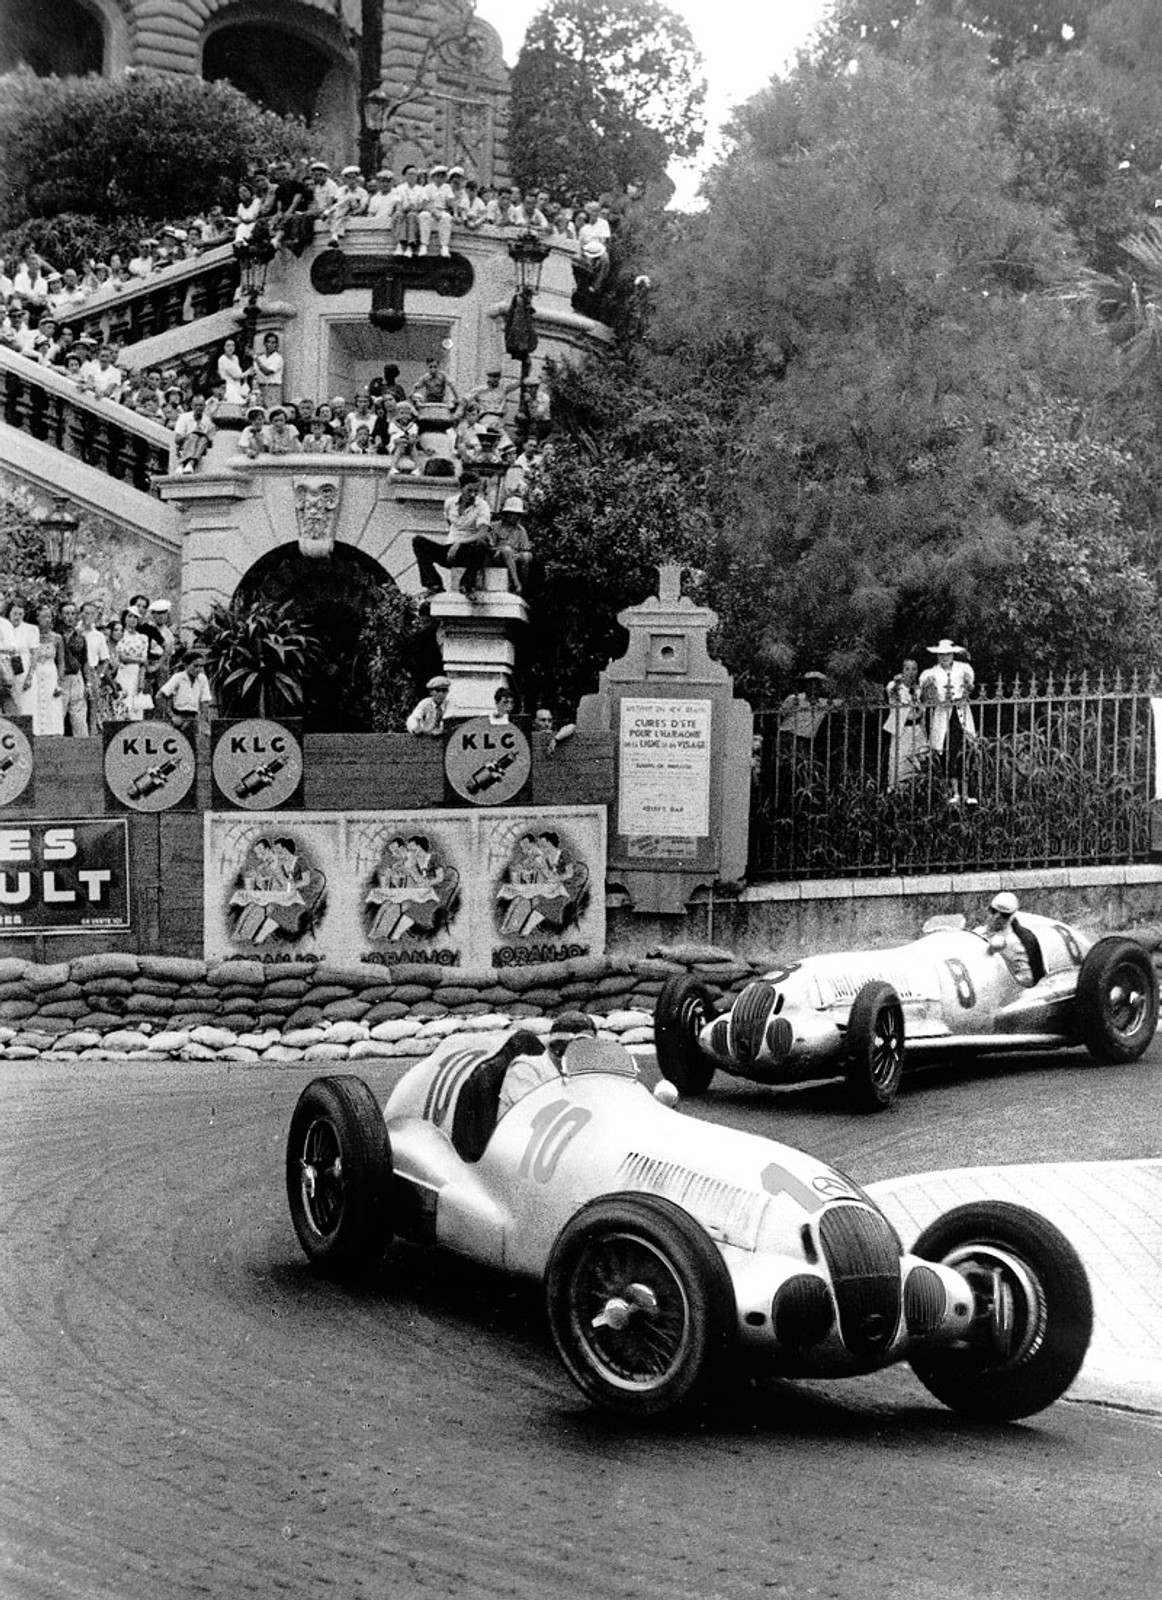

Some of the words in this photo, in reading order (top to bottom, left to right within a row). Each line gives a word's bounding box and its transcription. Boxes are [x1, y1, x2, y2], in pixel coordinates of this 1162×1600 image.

[635, 719, 666, 728] CURES
[123, 738, 179, 755] KLC
[230, 736, 286, 754] KLC
[462, 732, 515, 750] KLC
[0, 828, 77, 860] ES
[0, 869, 111, 904] ULT
[501, 945, 585, 963] ORANJO
[945, 957, 977, 1009] 8
[517, 1098, 593, 1184] 10
